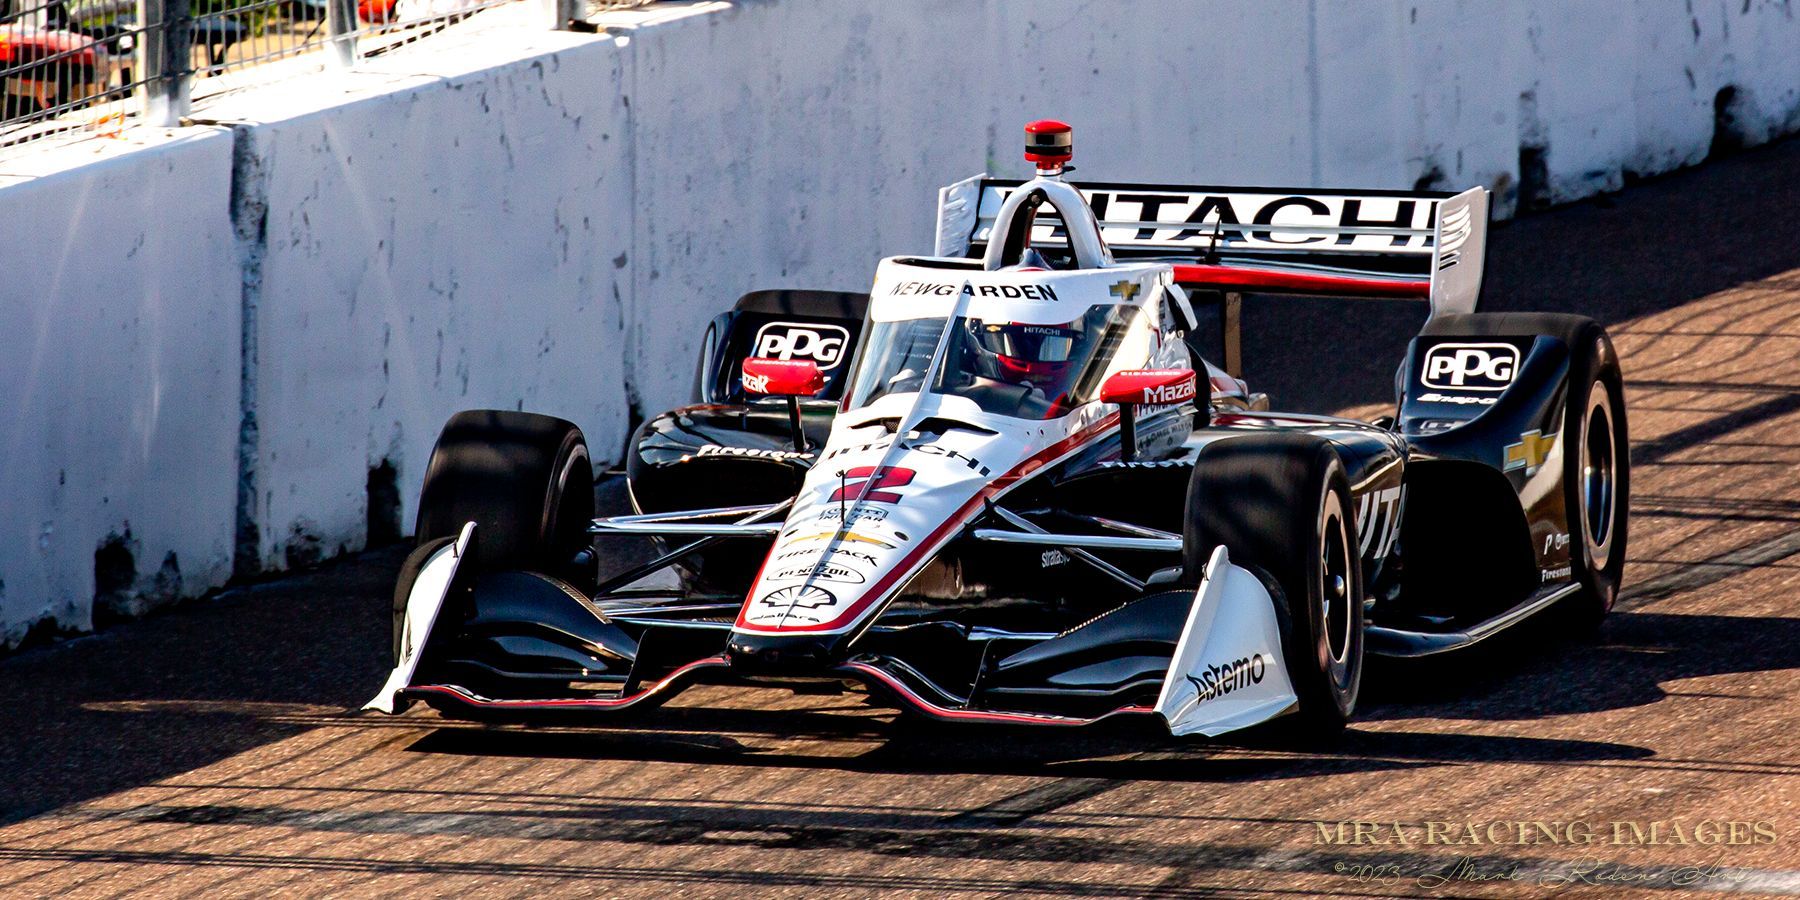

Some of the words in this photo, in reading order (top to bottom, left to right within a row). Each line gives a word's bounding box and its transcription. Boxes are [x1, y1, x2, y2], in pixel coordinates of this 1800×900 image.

[1001, 190, 1437, 247] ITACHI
[888, 279, 1058, 302] NEWGARDEN
[757, 328, 842, 361] PPG
[1023, 326, 1061, 337] HITACHI
[1428, 350, 1512, 386] PPG
[1416, 393, 1498, 405] Snap-o
[826, 466, 917, 505] 2
